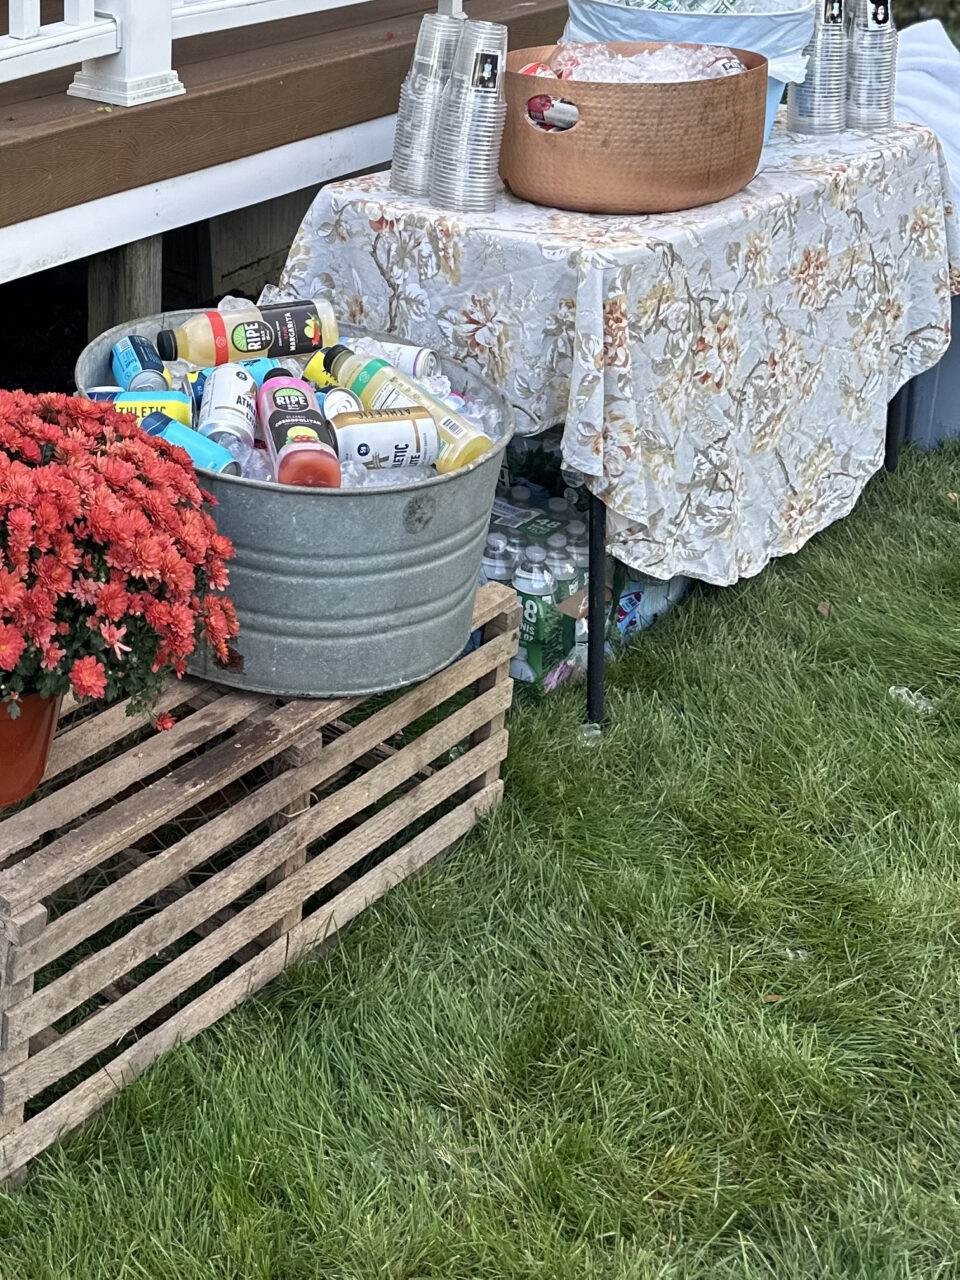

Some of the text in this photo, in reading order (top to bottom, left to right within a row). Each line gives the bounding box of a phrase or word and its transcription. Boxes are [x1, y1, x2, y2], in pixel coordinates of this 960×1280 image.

[247, 322, 262, 351] RIPE
[284, 313, 296, 351] MARGARITA
[276, 396, 307, 405] RIPE
[356, 408, 411, 419] ATHLETIC
